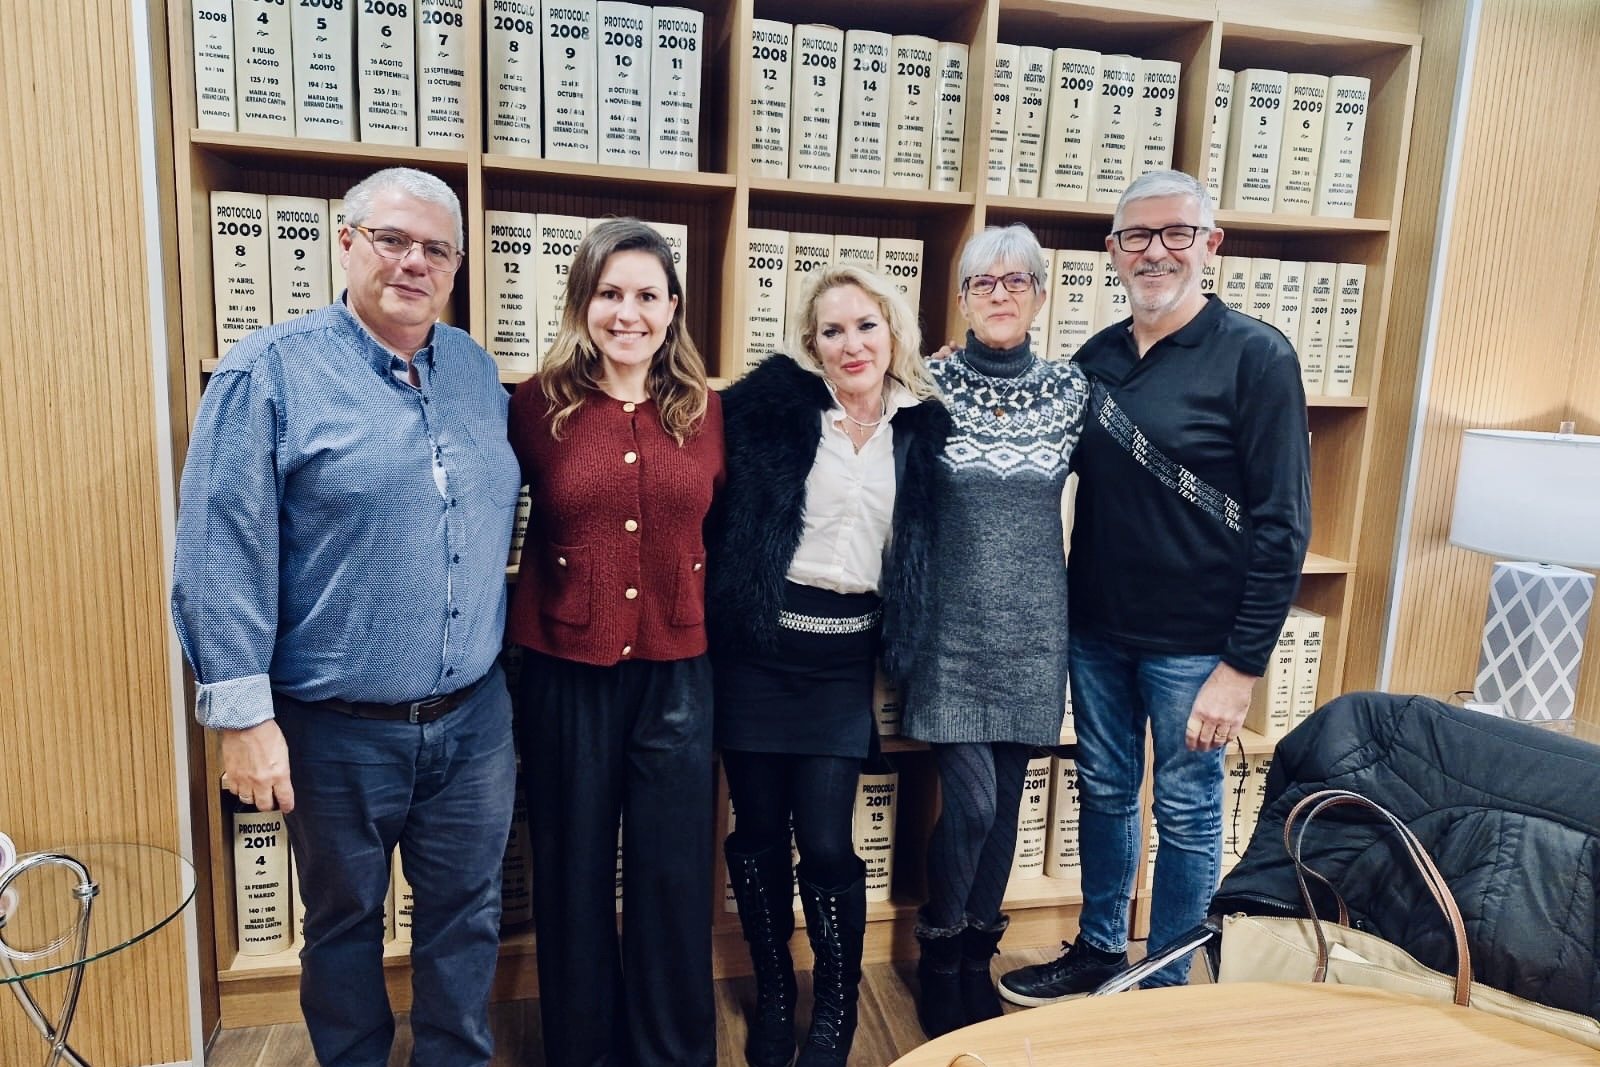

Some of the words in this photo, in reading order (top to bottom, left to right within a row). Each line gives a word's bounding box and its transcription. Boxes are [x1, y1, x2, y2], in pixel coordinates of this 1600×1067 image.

[364, 0, 408, 18] 2008
[493, 0, 535, 17] PROTOCOLO
[198, 10, 228, 23] 2008
[257, 12, 269, 24] 4
[422, 11, 463, 27] 2008
[550, 8, 590, 23] PROTOCOLO
[316, 17, 327, 29] 5
[493, 16, 534, 35] 2008
[604, 16, 644, 31] PROTOCOLO
[658, 19, 697, 34] PROTOCOLO
[381, 25, 392, 37] 6
[550, 24, 590, 40] 2008
[438, 34, 449, 46] 7
[604, 32, 643, 49] 2008
[658, 35, 696, 51] 2008
[752, 30, 789, 46] PROTOCOLO
[509, 40, 519, 53] 8
[801, 37, 838, 53] PROTOCOLO
[565, 47, 576, 59] 9
[752, 46, 788, 63] 2008
[897, 48, 932, 62] PROTOCOLO
[252, 58, 279, 67] AGOSTO
[615, 54, 632, 67] 10
[672, 58, 683, 70] 11
[802, 53, 837, 69] 2008
[995, 59, 1010, 69] LIBRO
[309, 63, 336, 72] AGOSTO
[897, 63, 931, 79] 2008
[1029, 63, 1043, 73] LIBRO
[1061, 62, 1095, 76] PROTOCOLO
[762, 69, 777, 80] 12
[1023, 73, 1046, 84] REGISTRO
[1103, 69, 1136, 83] PROTOCOLO
[1143, 72, 1177, 84] PROTOCOLO
[267, 77, 279, 85] 193
[812, 75, 826, 87] 13
[863, 80, 877, 92] 14
[1060, 77, 1094, 92] 2009
[907, 85, 921, 96] 15
[1102, 83, 1134, 98] 2009
[1142, 86, 1175, 100] 2009
[1250, 82, 1282, 95] PROTOCOLO
[1294, 86, 1325, 99] PROTOCOLO
[1336, 88, 1366, 100] PROTOCOLO
[941, 93, 961, 103] 2008
[1022, 97, 1042, 106] 2008
[1073, 98, 1079, 109] 1
[1249, 96, 1280, 109] 2009
[1113, 105, 1121, 114] 2
[1154, 107, 1162, 117] 3
[1292, 99, 1323, 113] 2009
[1335, 102, 1364, 115] 2009
[245, 112, 286, 121] VINAROS
[1259, 116, 1267, 125] 5
[1302, 119, 1311, 129] 6
[1347, 121, 1354, 131] 7
[217, 206, 262, 220] PROTOCOLO
[276, 211, 320, 224] PROTOCOLO
[217, 221, 262, 237] 2009
[277, 226, 320, 241] 2009
[491, 225, 532, 238] PROTOCOLO
[542, 227, 582, 240] PROTOCOLO
[235, 245, 246, 257] 8
[491, 240, 532, 255] 2009
[749, 242, 784, 254] PROTOCOLO
[795, 245, 830, 258] PROTOCOLO
[294, 249, 306, 260] 9
[840, 248, 875, 260] PROTOCOLO
[885, 250, 919, 262] PROTOCOLO
[503, 263, 520, 274] 12
[555, 264, 569, 275] 13
[748, 257, 783, 270] 2009
[1062, 261, 1094, 272] PROTOCOLO
[885, 265, 918, 277] 2009
[1260, 272, 1272, 281] LIBRO
[759, 277, 773, 287] 16
[1061, 274, 1093, 287] 2009
[1254, 281, 1274, 290] REGISTRO
[1346, 279, 1359, 287] LIBRO
[1068, 293, 1084, 303] 22
[1112, 294, 1127, 304] 23
[1340, 307, 1358, 315] 2009
[863, 784, 895, 793] PROTOCOLO
[1025, 779, 1046, 789] 2011
[866, 795, 891, 807] 2011
[1030, 795, 1041, 803] 18
[871, 812, 884, 821] 15
[239, 821, 280, 834] PROTOCOLO
[244, 835, 276, 848] 2011
[255, 856, 266, 865] 4
[252, 882, 279, 890] FEBRERO
[245, 934, 282, 942] VINAROS
